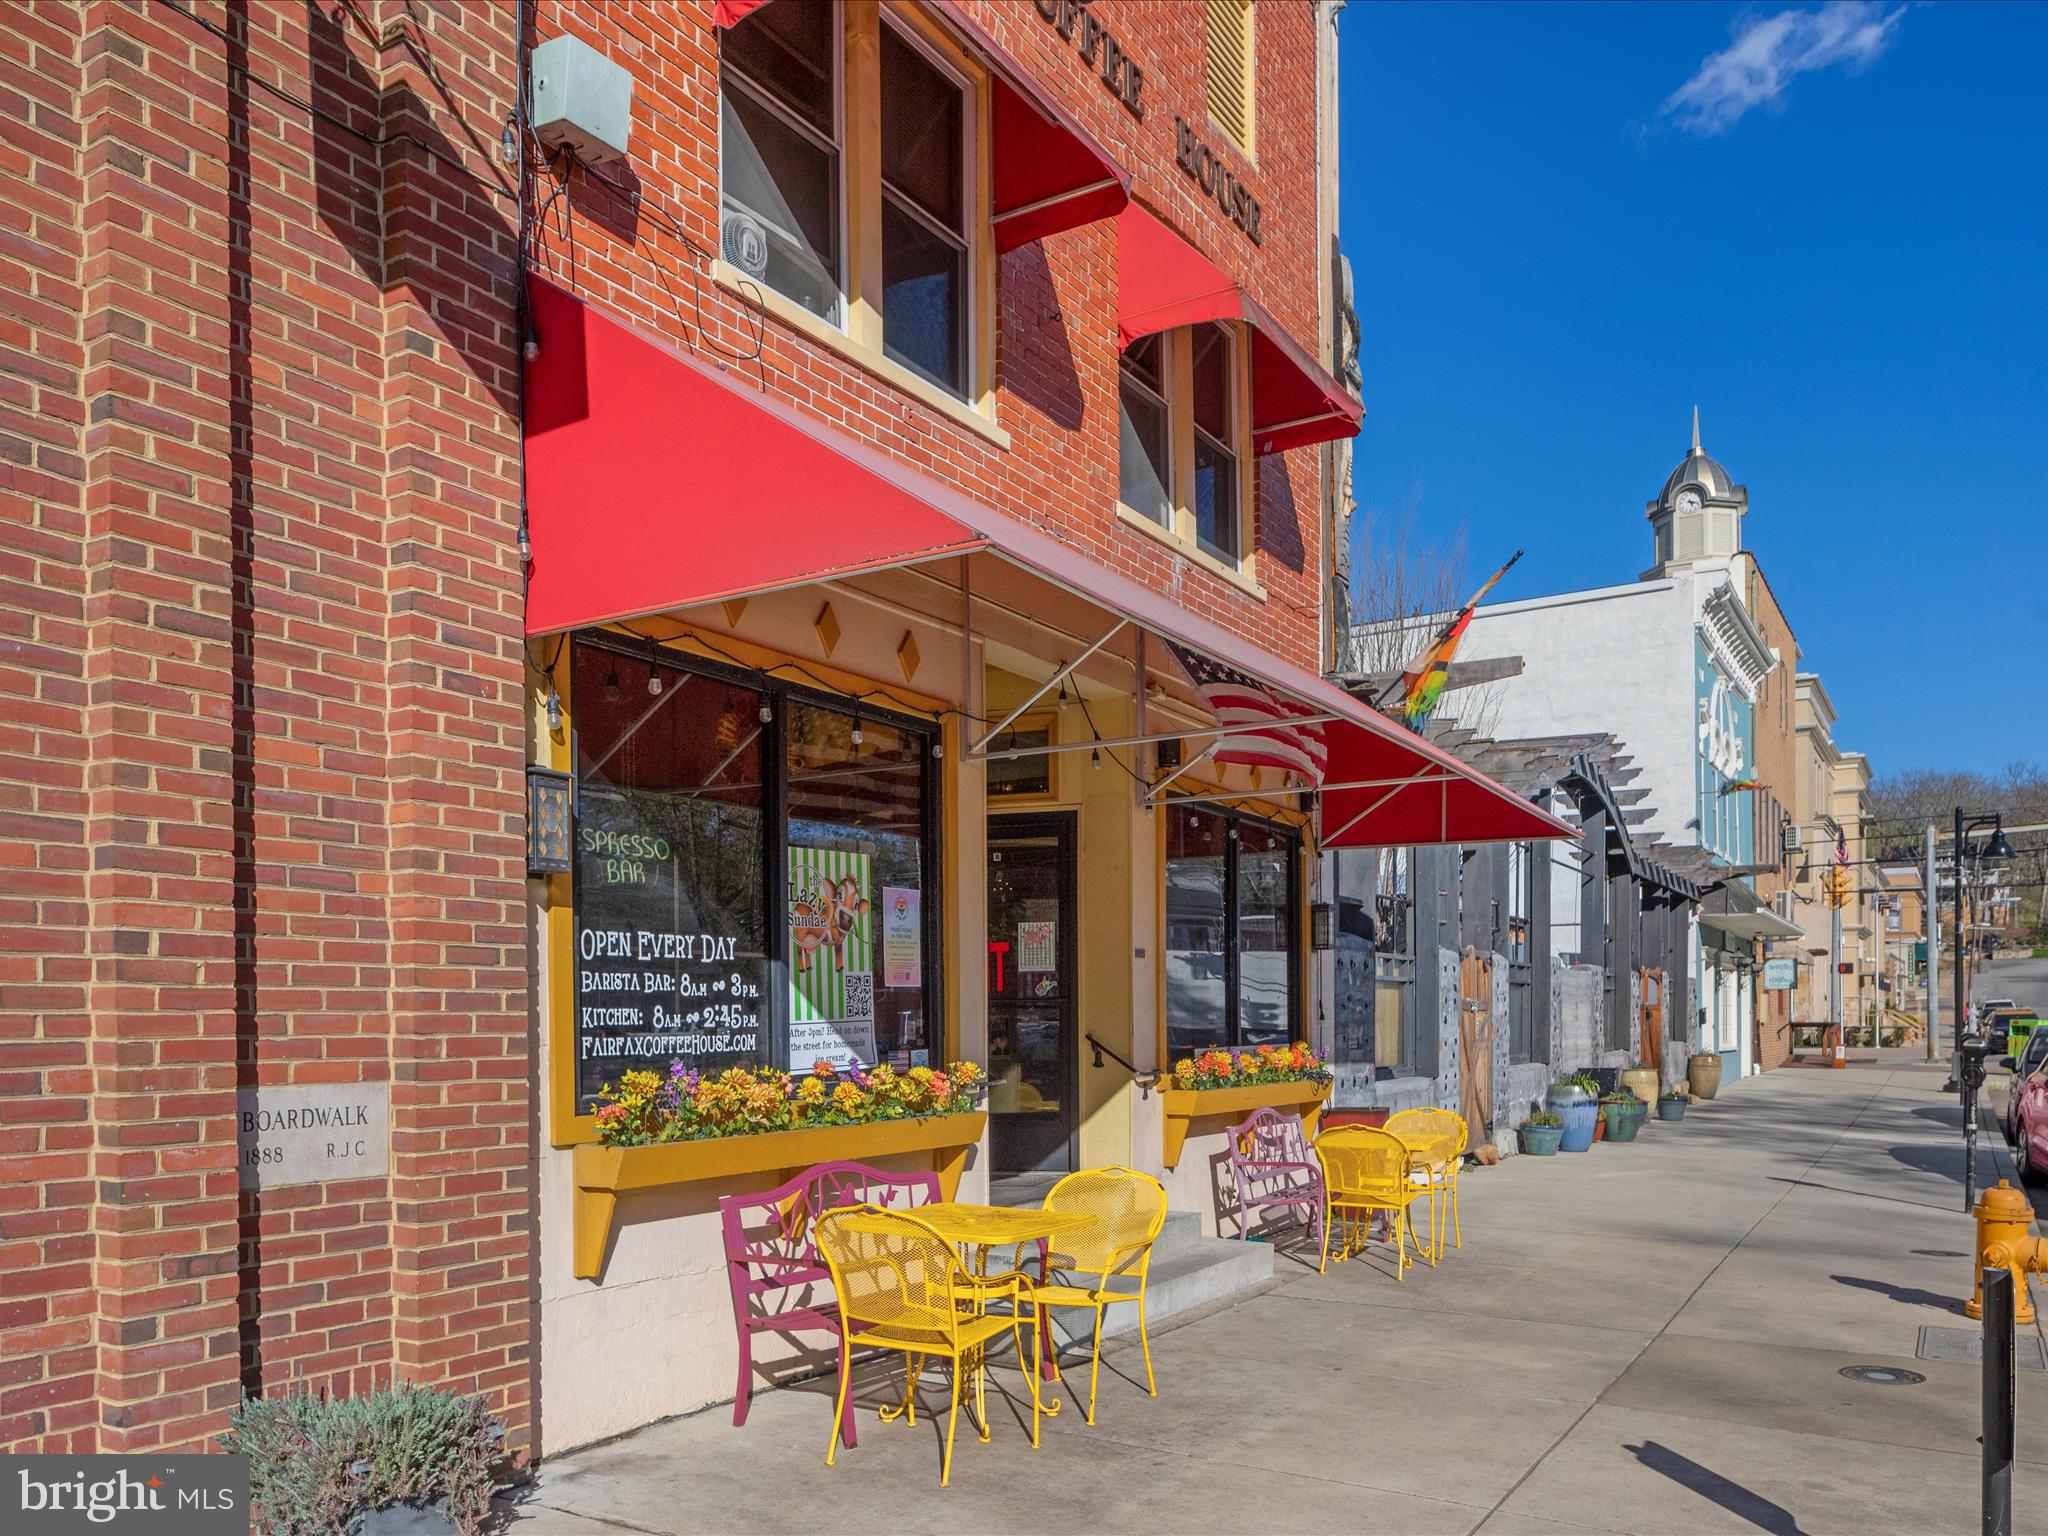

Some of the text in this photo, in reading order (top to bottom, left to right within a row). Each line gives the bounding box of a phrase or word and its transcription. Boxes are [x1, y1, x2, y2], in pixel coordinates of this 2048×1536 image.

[1175, 116, 1262, 248] HOUSE
[607, 859, 646, 883] BAR
[788, 881, 826, 915] Lazy
[788, 911, 826, 927] Sundae
[580, 929, 737, 963] OPEN EVERY DAY
[581, 971, 640, 993] BARISTA
[644, 972, 676, 994] BAR:
[582, 1007, 644, 1029] KITCHEN:
[791, 1042, 802, 1052] the
[803, 1041, 821, 1051] street
[822, 1040, 833, 1050] for
[242, 1104, 369, 1133] BOARDWALK
[245, 1146, 284, 1166] 1888
